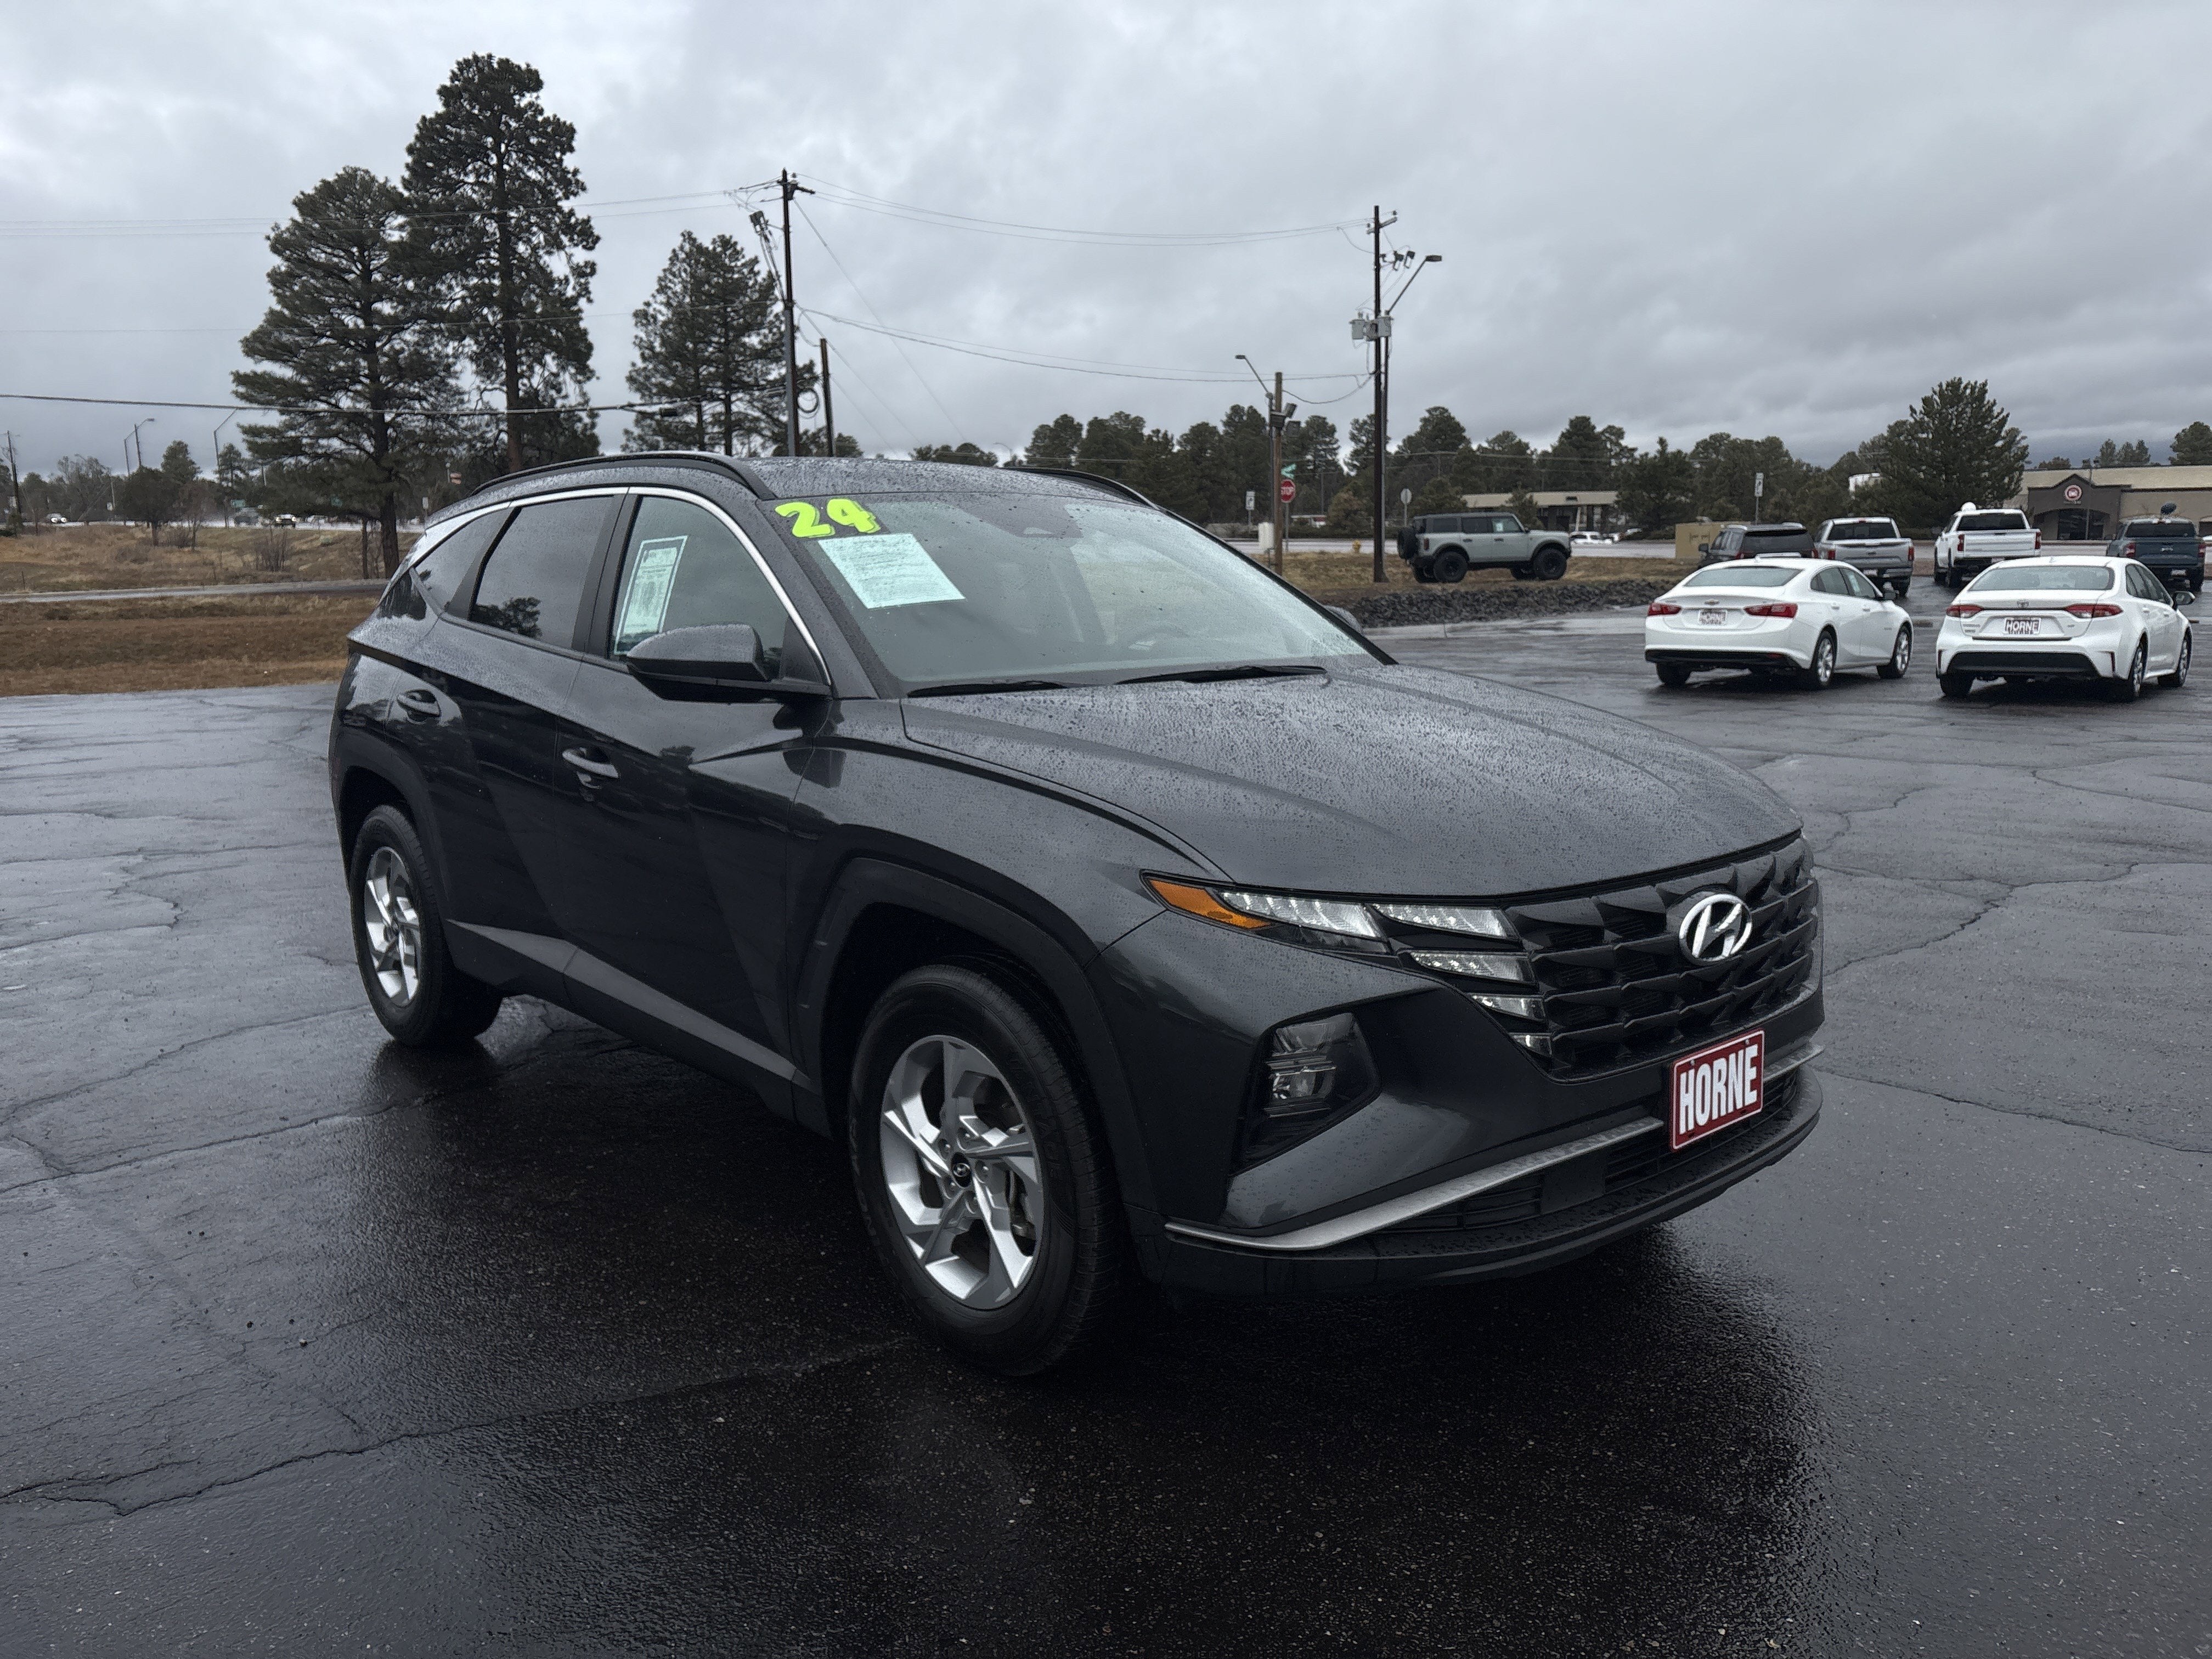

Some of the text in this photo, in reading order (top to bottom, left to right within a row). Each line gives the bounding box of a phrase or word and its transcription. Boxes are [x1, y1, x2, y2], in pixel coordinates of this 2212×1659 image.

[775, 499, 881, 538] 24
[2006, 620, 2039, 632] HORNE
[1679, 1044, 1758, 1135] HORNE
